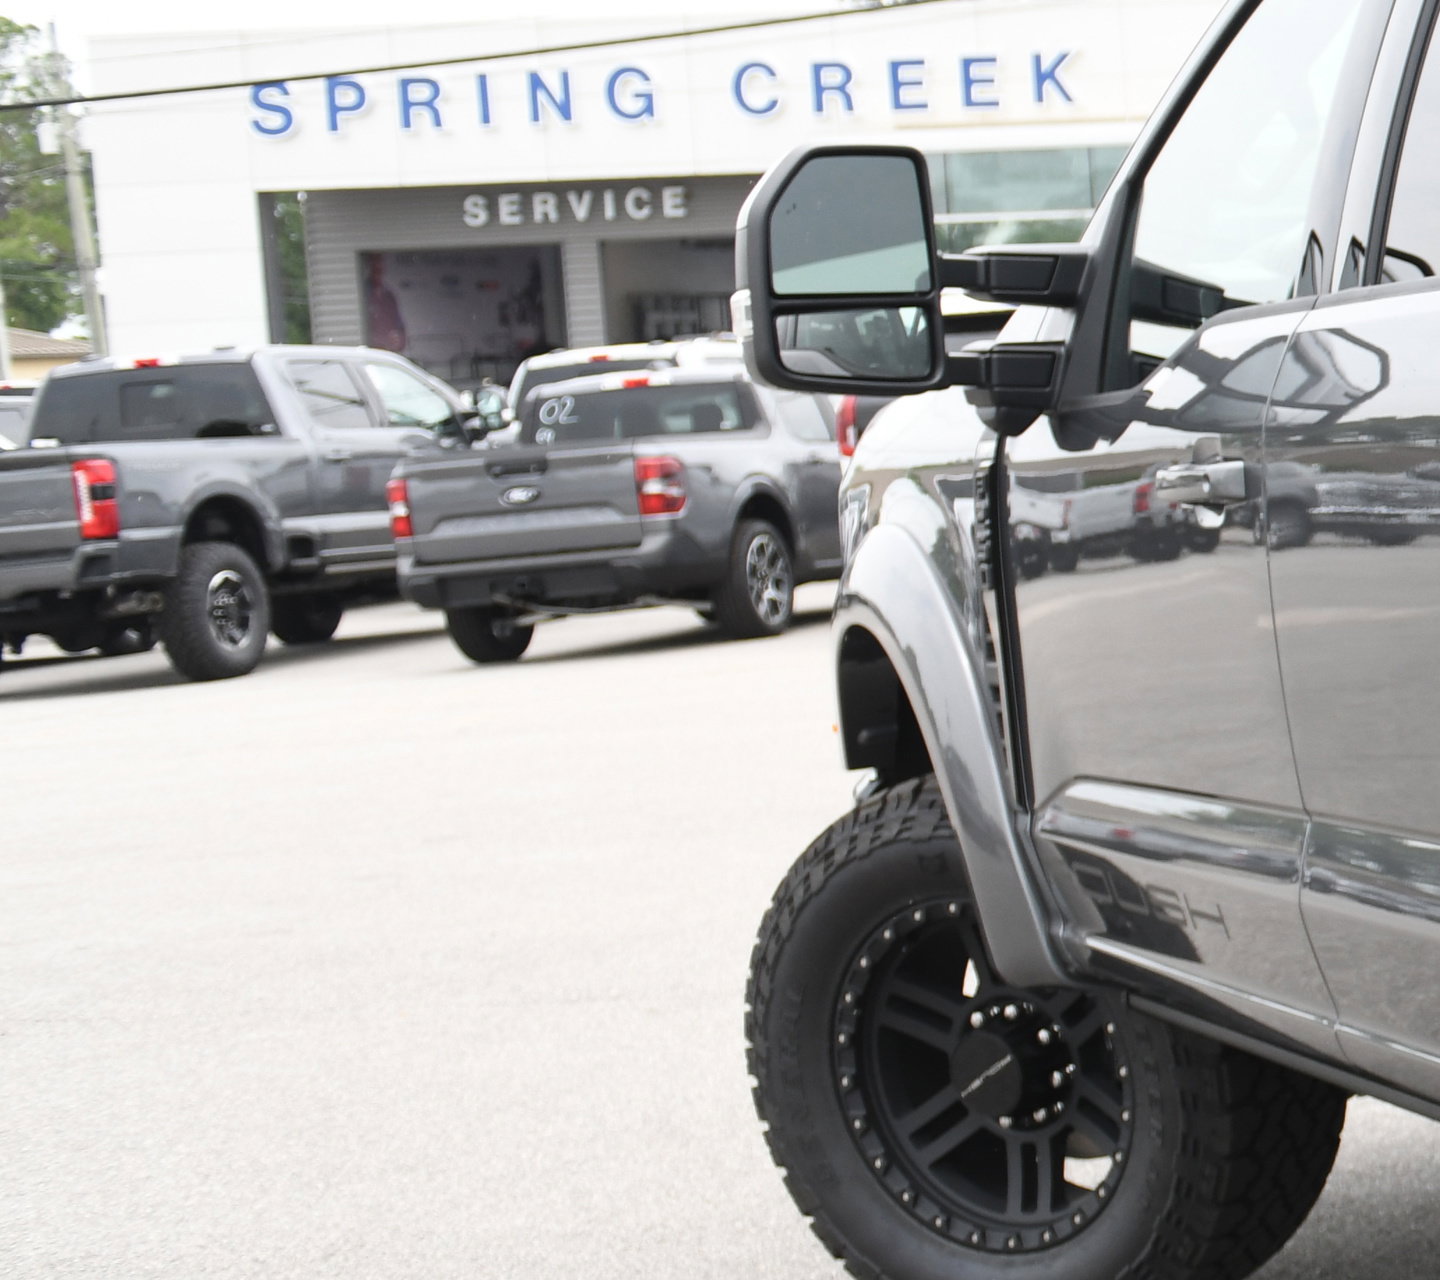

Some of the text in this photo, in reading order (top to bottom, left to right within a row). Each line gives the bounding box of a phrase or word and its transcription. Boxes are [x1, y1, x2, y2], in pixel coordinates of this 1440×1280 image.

[251, 52, 1073, 136] SPRING CREEK
[463, 185, 688, 227] SERVICE
[1071, 861, 1231, 942] OUSH
